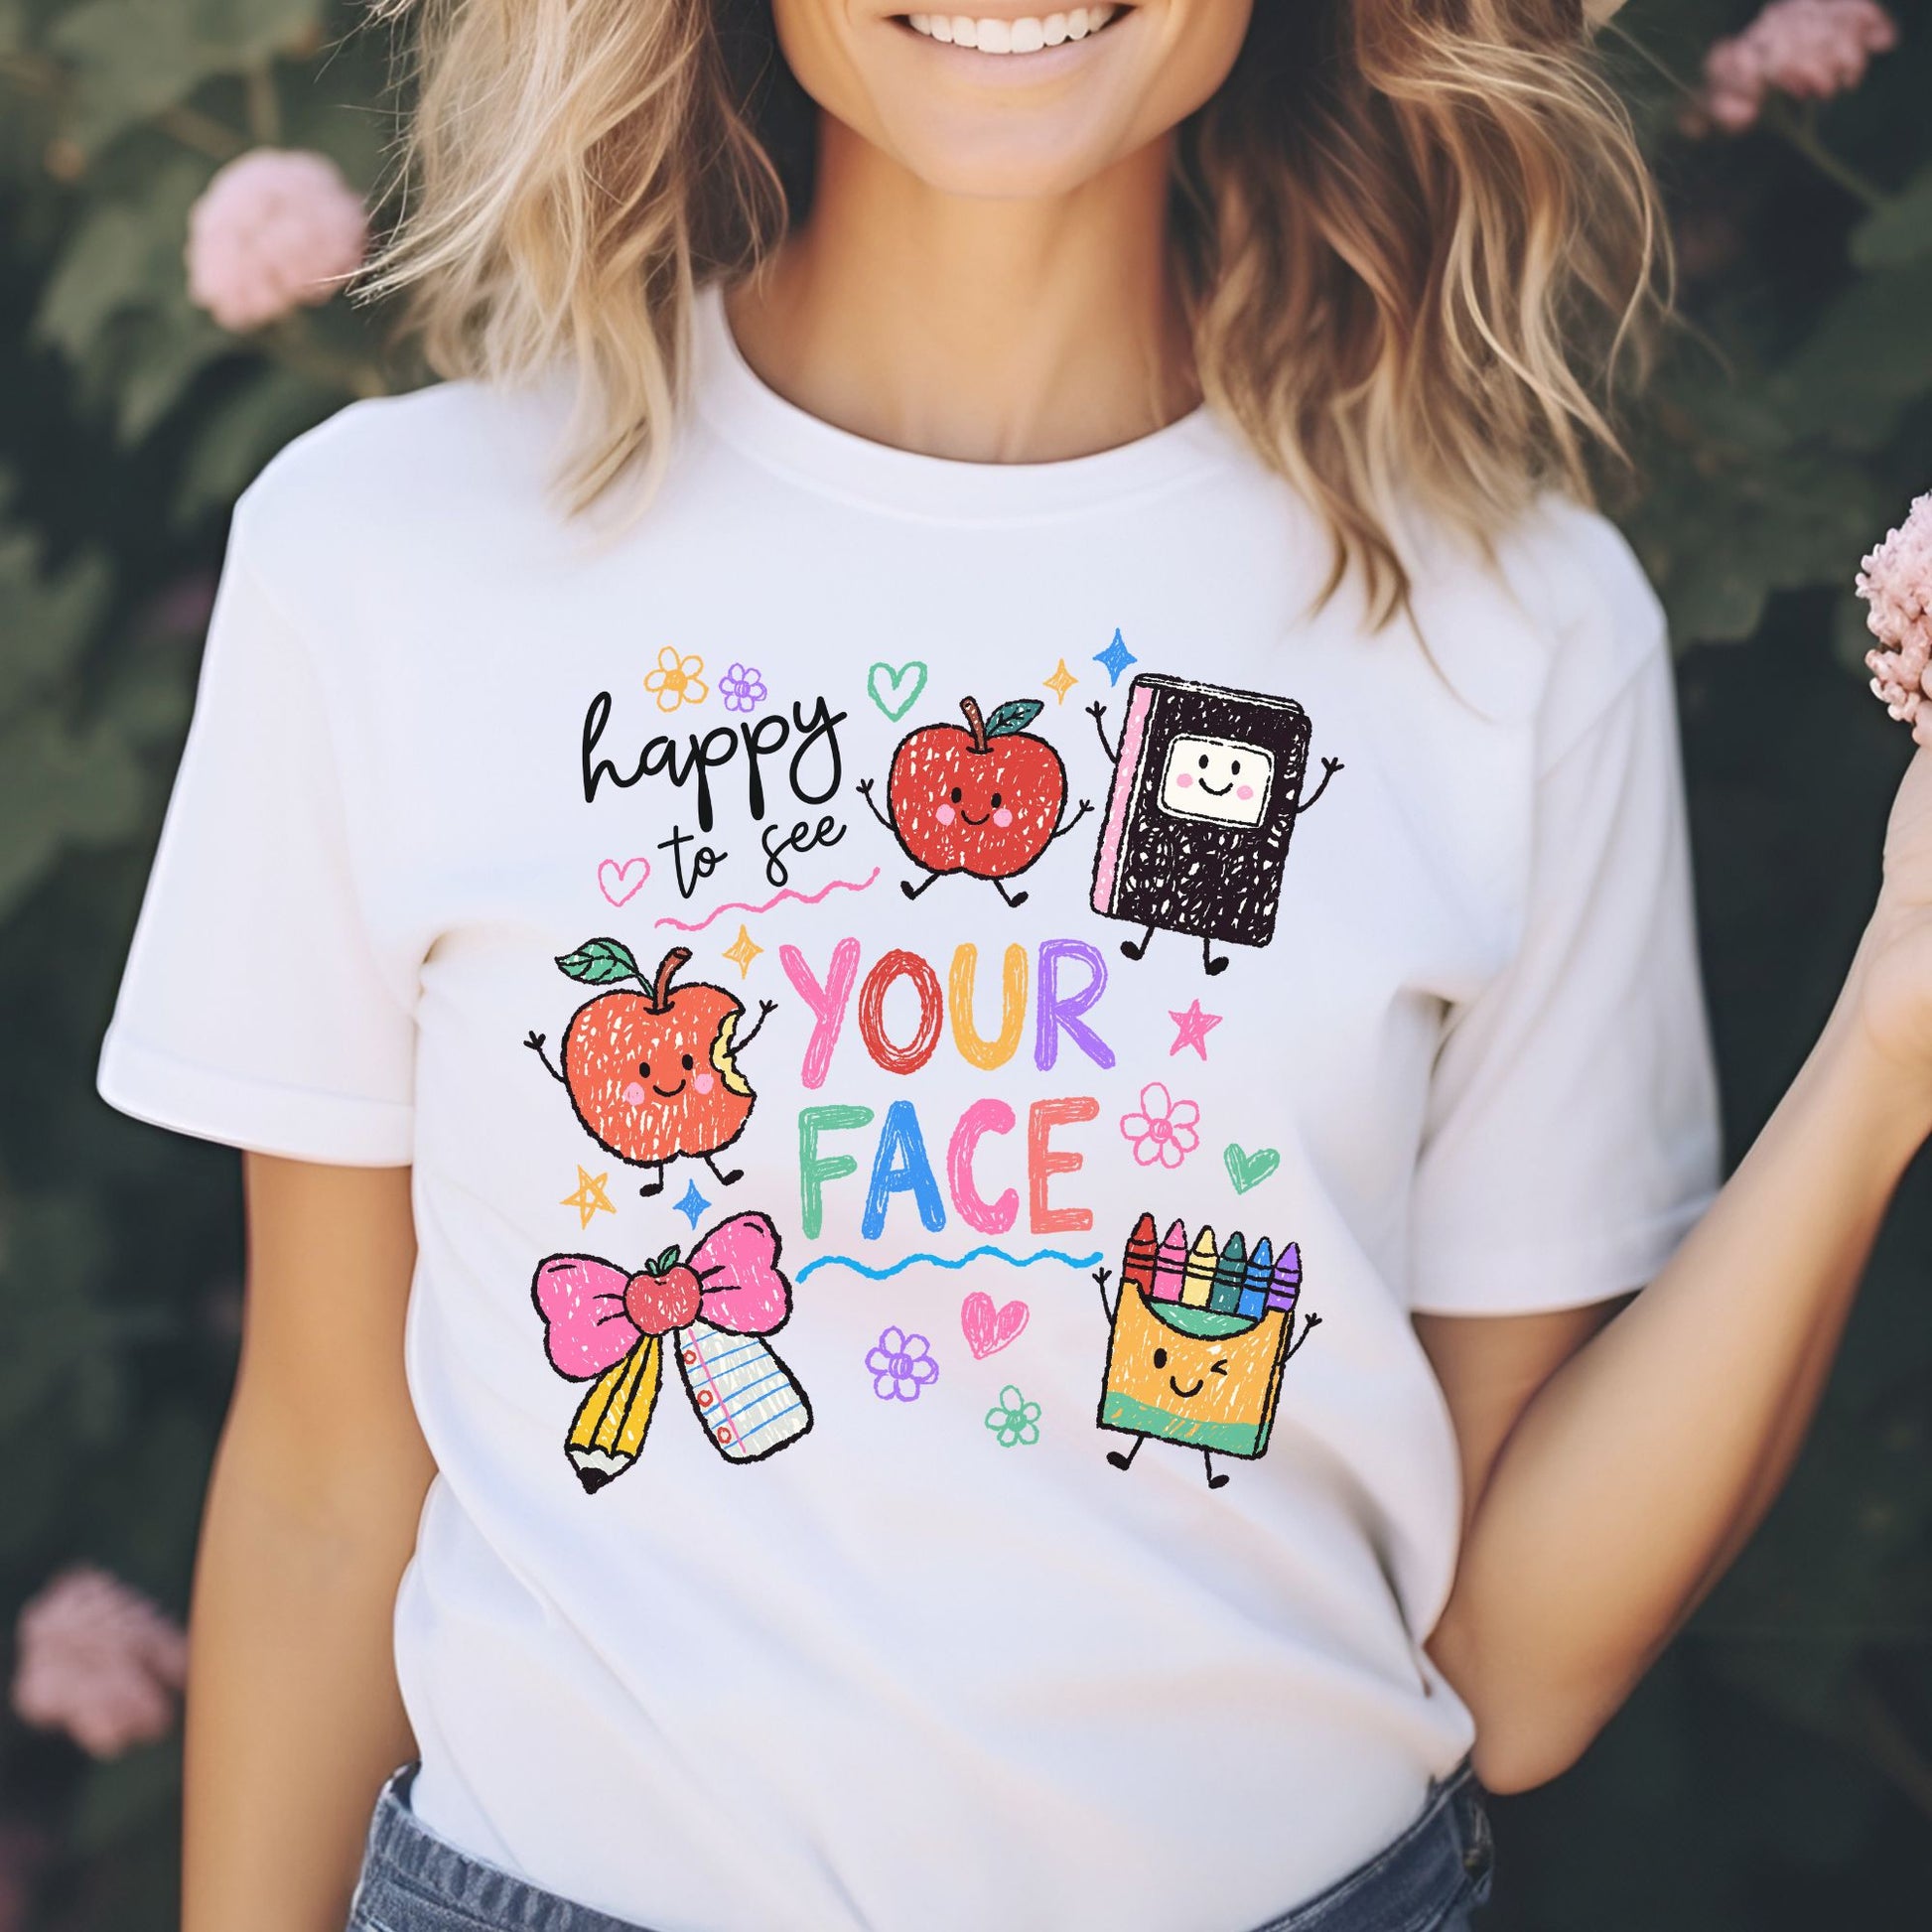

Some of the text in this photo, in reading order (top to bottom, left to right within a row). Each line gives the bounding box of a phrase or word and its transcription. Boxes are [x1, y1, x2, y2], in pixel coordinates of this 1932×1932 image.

[581, 690, 848, 834] happy
[656, 814, 848, 899] to see
[779, 936, 1116, 1090] YOUR
[797, 1096, 1100, 1241] FACE
